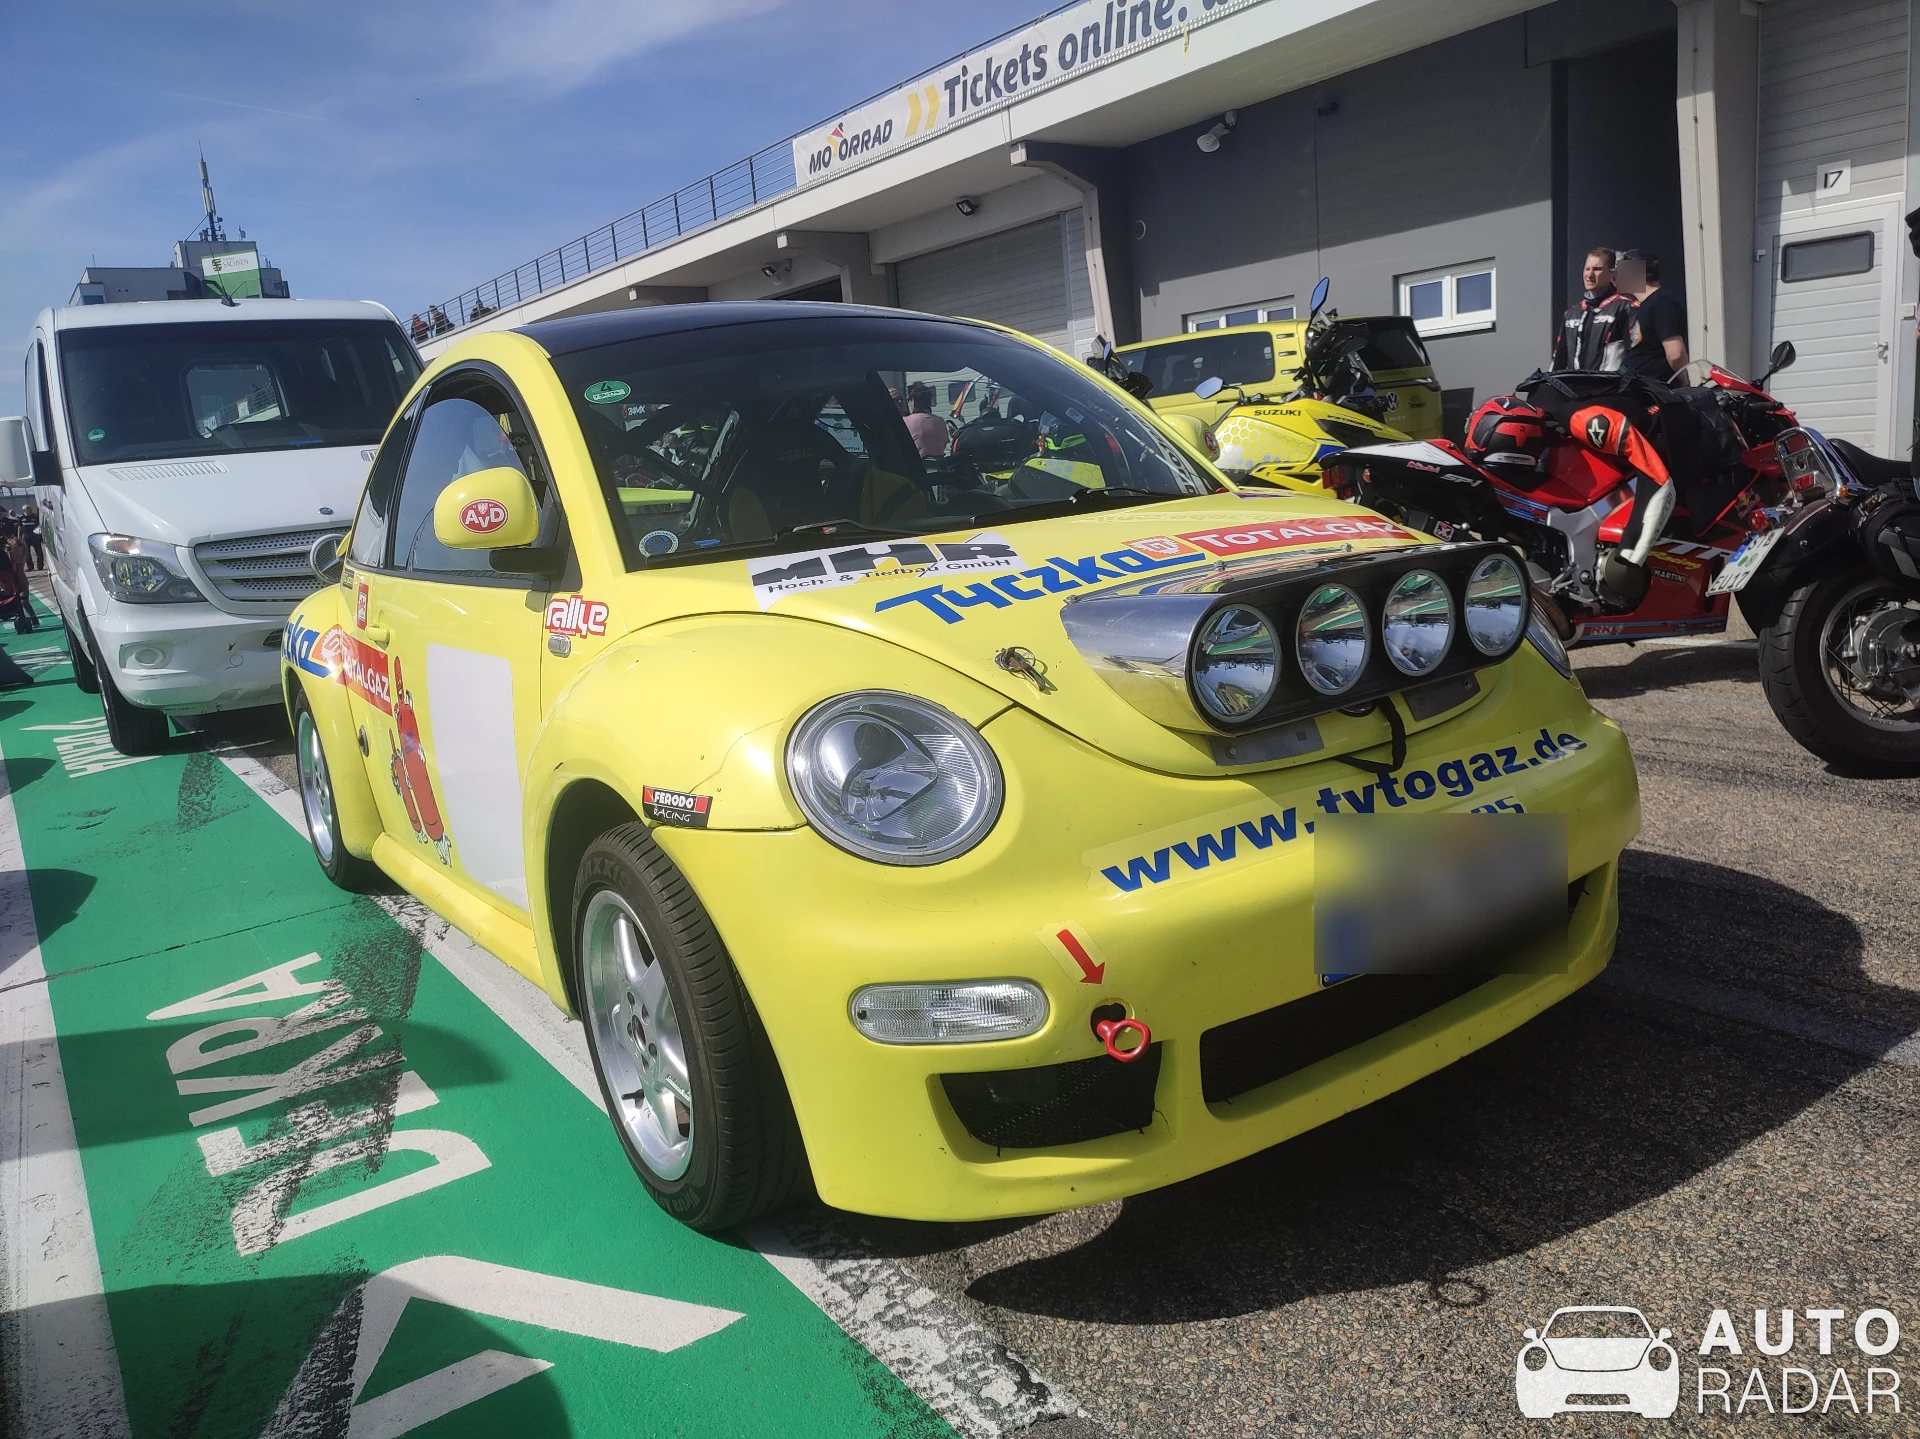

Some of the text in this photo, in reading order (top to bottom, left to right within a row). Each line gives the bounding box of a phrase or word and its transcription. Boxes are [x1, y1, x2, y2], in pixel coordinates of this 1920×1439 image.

[943, 0, 1188, 119] Tickets online.
[1823, 169, 1843, 189] 17
[1254, 409, 1301, 417] SUZUKI
[1190, 521, 1406, 548] TOTALGAZ
[752, 543, 1018, 587] MHR
[768, 579, 833, 594] Hoch-
[861, 565, 939, 579] Tiefbau
[946, 559, 1011, 570] GmbH
[1653, 569, 1687, 584] MARTINI
[546, 597, 608, 636] rallye
[654, 790, 695, 809] FERODO
[653, 807, 692, 823] RACING
[146, 951, 493, 1257] DEKRA
